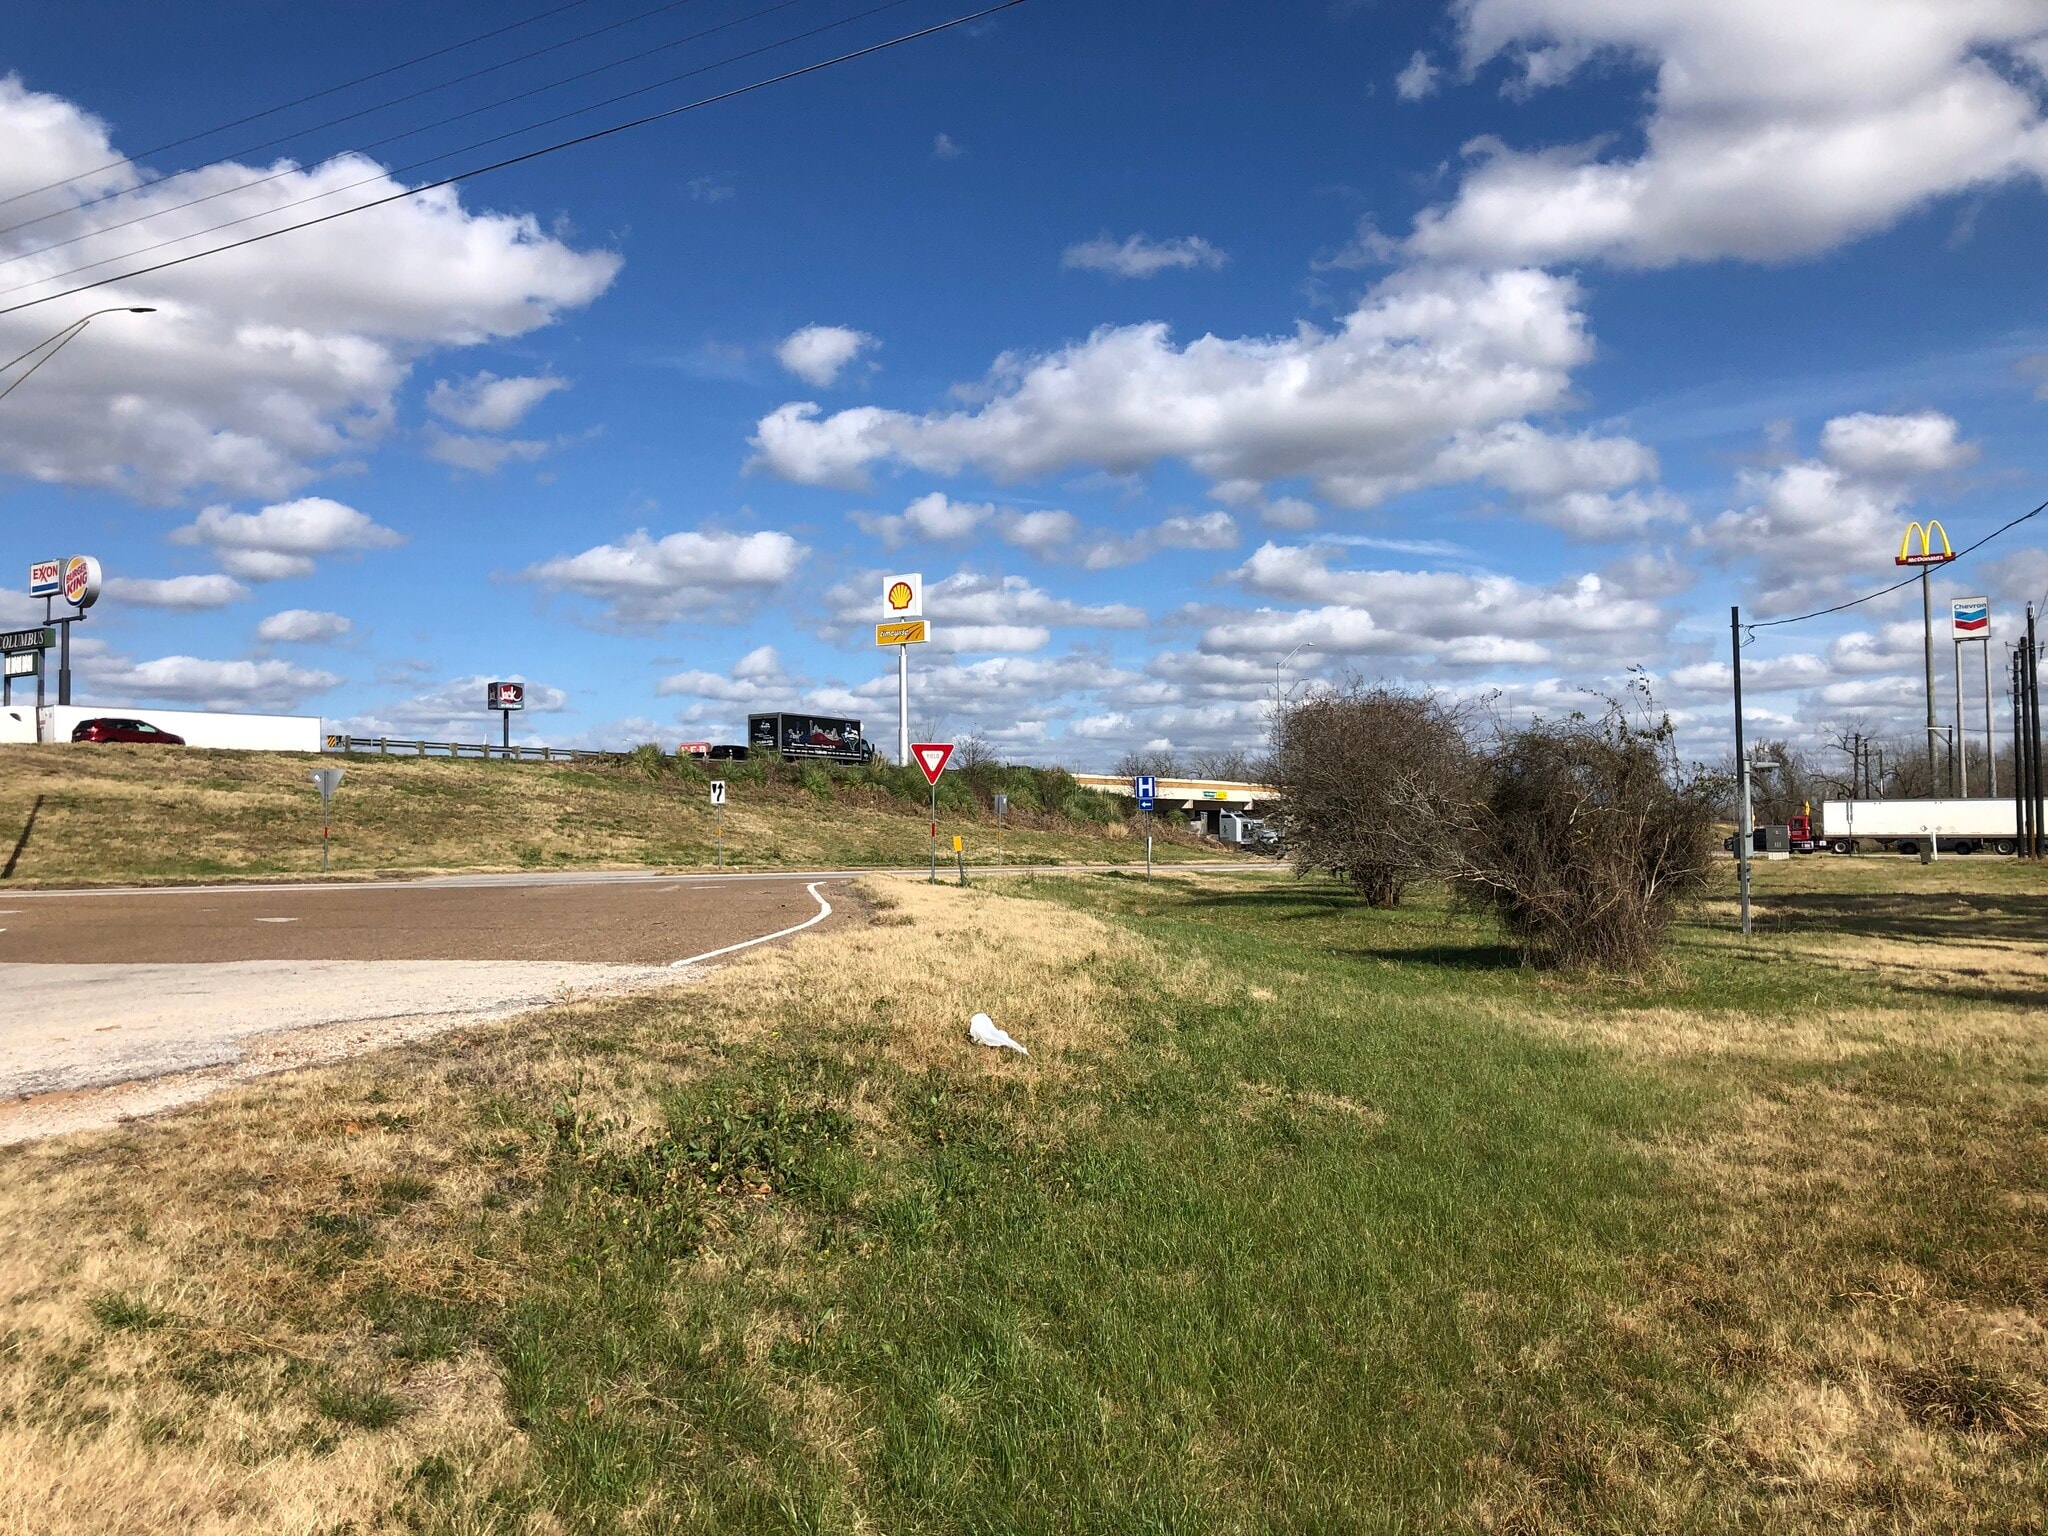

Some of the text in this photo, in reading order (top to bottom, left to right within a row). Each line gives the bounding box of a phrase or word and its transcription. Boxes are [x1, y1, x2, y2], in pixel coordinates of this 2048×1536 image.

[33, 565, 58, 582] EXXON
[66, 562, 87, 584] BURGER
[67, 572, 88, 597] KING
[1138, 777, 1153, 797] H
